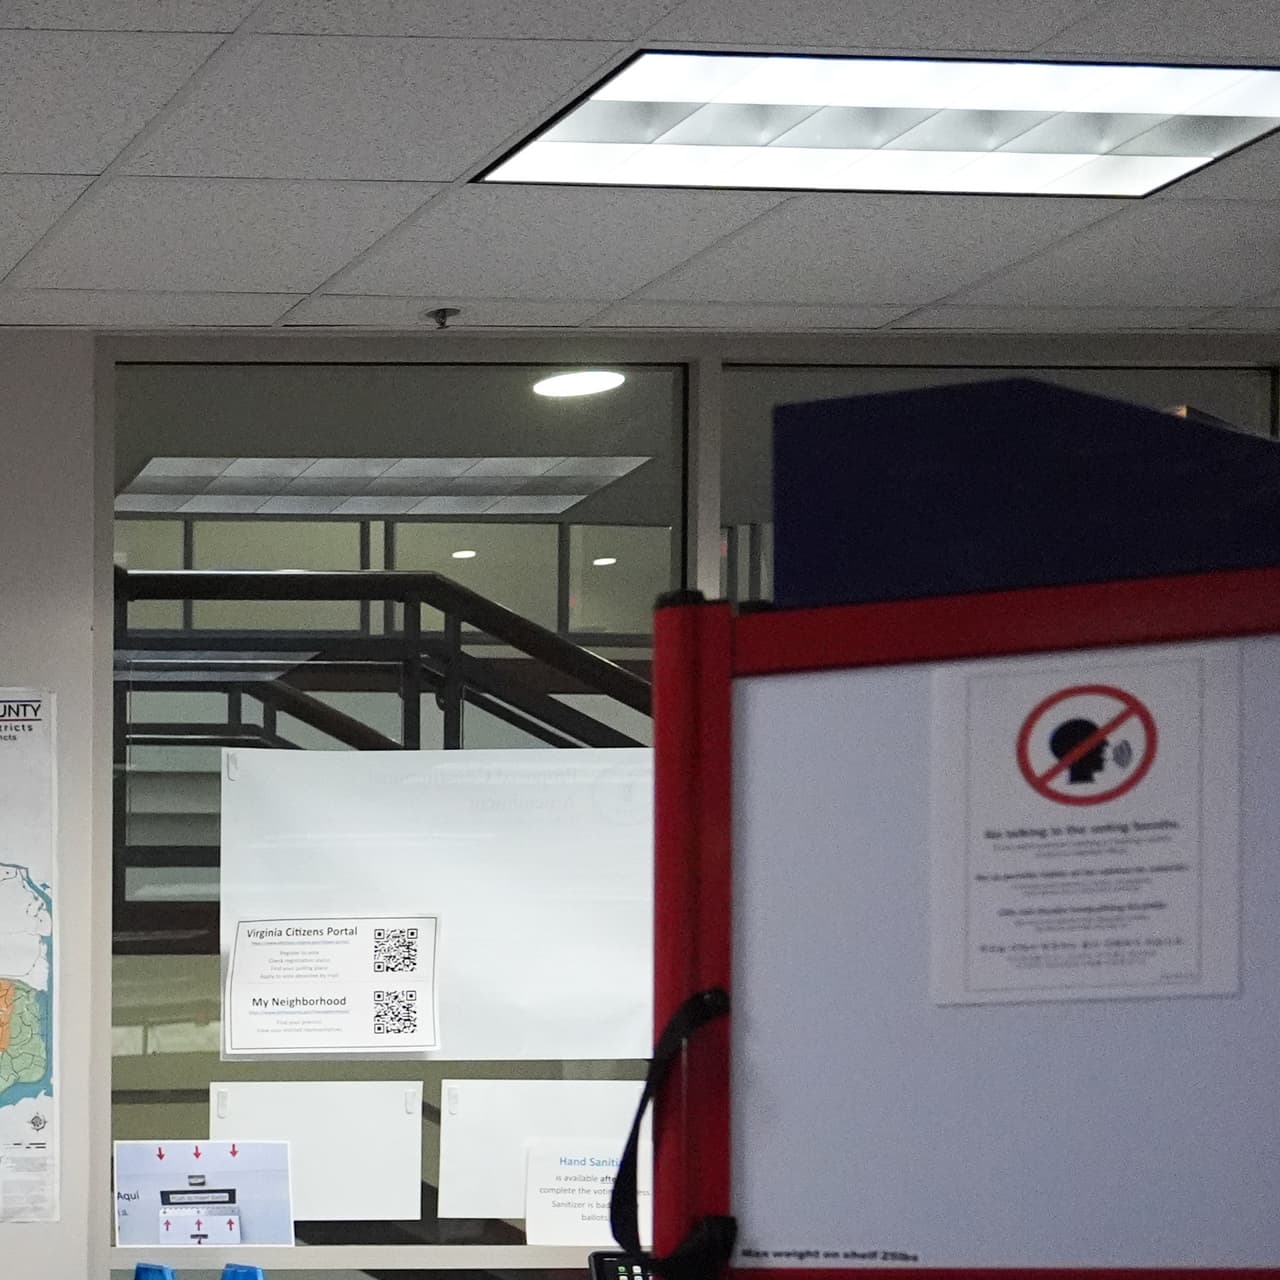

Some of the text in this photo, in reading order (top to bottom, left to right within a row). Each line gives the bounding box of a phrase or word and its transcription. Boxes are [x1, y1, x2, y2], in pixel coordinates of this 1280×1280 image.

[247, 926, 358, 939] Virginia Citizens Portal
[252, 997, 347, 1009] My Neighborhood
[559, 1157, 623, 1167] Hand Saniti
[539, 1187, 576, 1196] complete
[551, 1200, 586, 1209] Sanitizer
